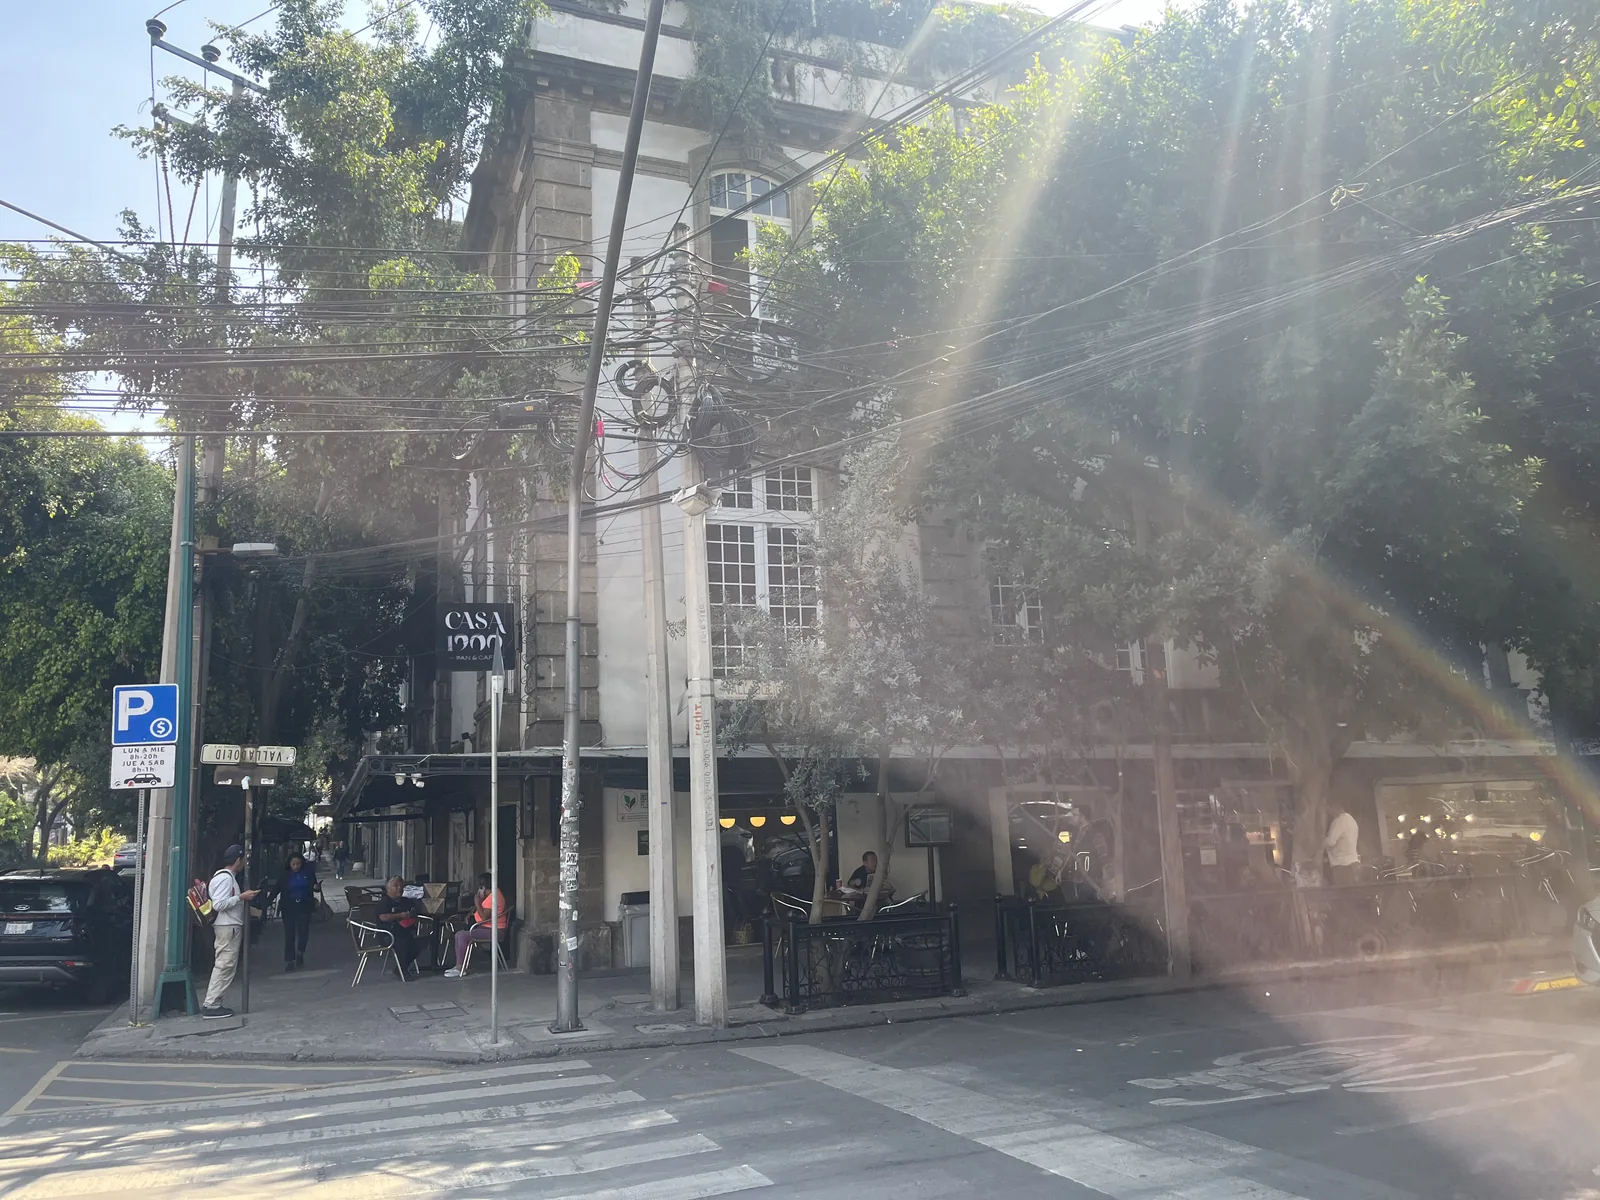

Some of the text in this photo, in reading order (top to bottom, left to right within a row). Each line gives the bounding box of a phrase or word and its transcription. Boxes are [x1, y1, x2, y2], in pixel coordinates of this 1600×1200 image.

[445, 611, 507, 634] CASA
[118, 690, 154, 731] P
[215, 749, 282, 762] VALLADOLID
